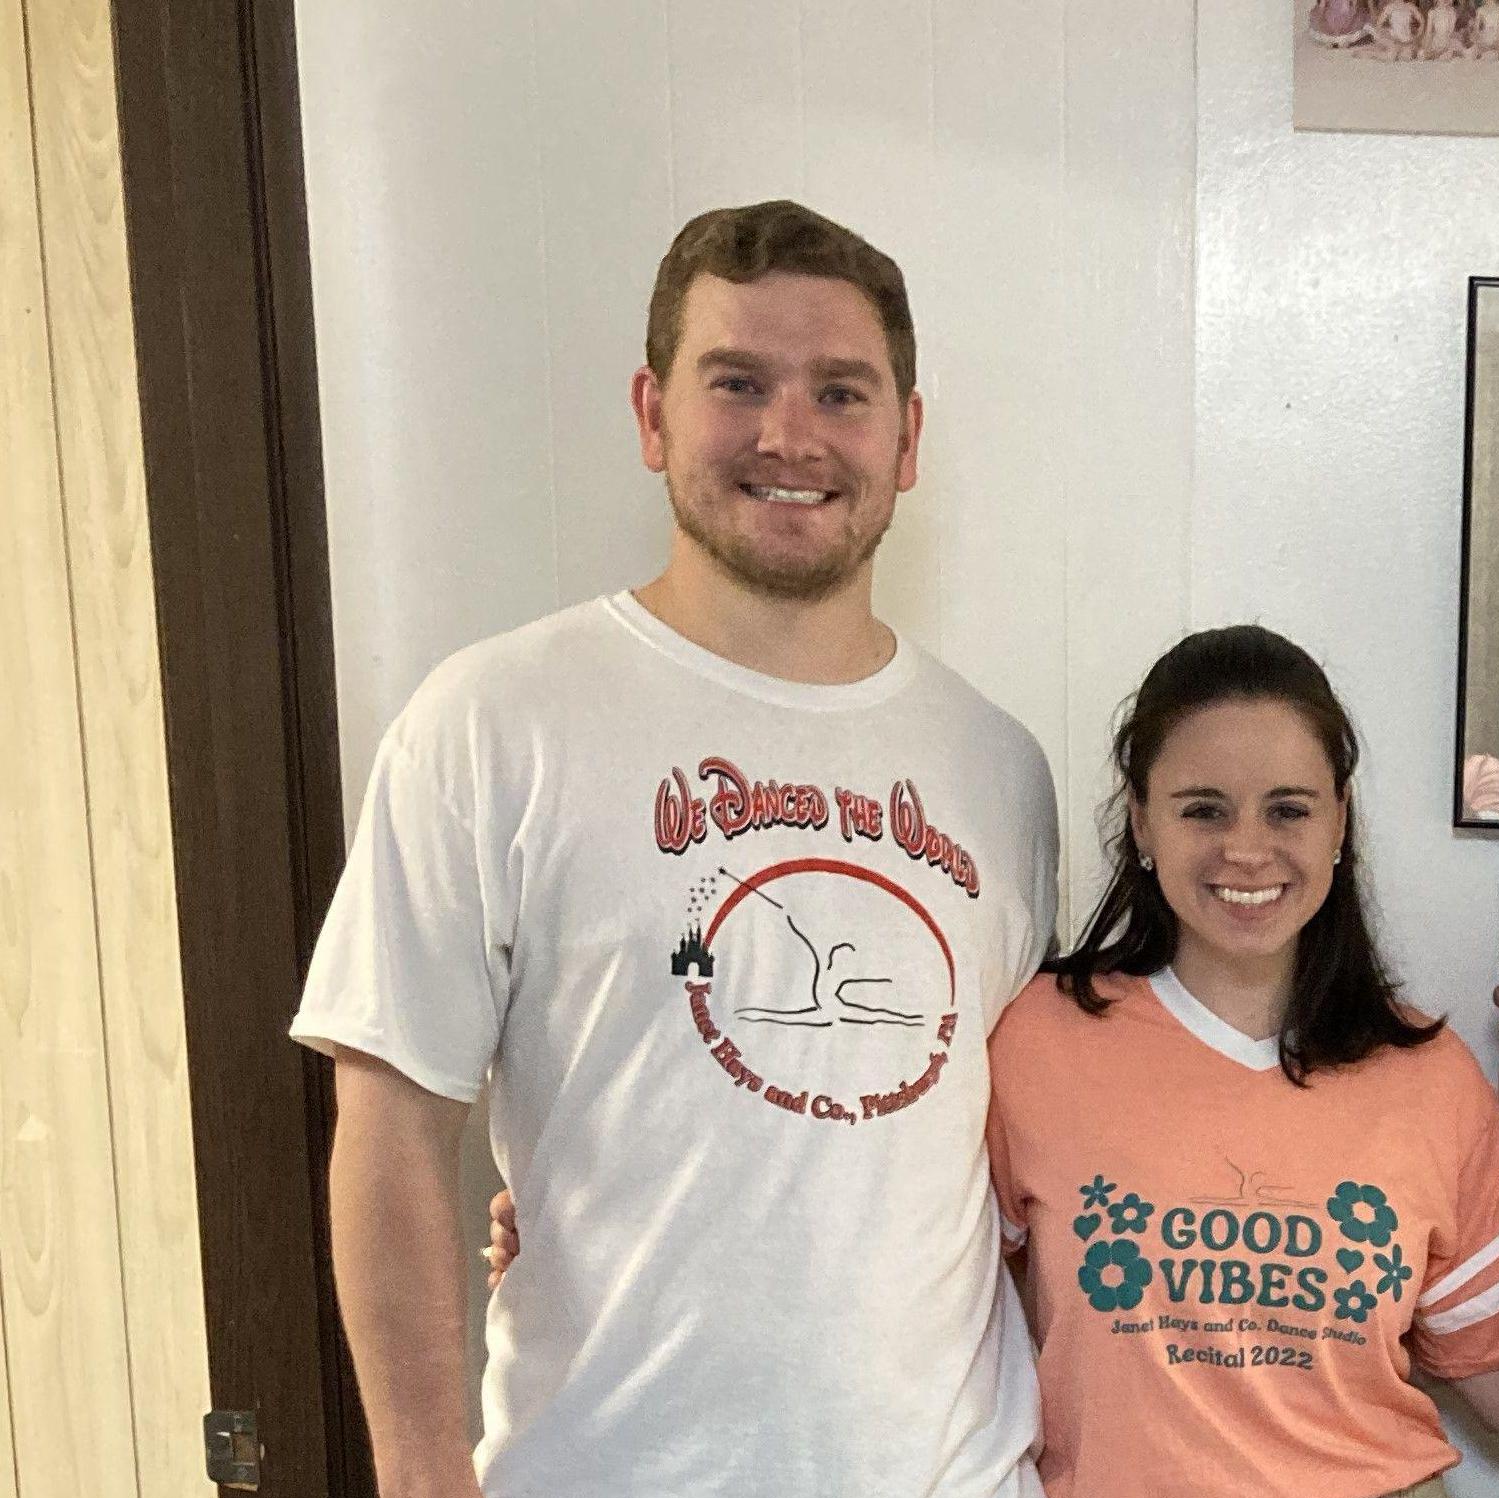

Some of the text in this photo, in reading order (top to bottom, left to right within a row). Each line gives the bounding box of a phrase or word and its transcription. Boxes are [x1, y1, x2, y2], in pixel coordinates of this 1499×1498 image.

[699, 756, 829, 840] DANCED
[835, 786, 883, 843] THE
[764, 1085, 809, 1115] and
[1161, 1207, 1322, 1257] GOOD
[1159, 1258, 1328, 1312] VIBES
[1159, 1315, 1198, 1332] Hays
[1204, 1318, 1233, 1332] and
[1239, 1319, 1262, 1331] Co.
[1267, 1319, 1317, 1340] Dance
[1166, 1343, 1313, 1370] Recital 2022
